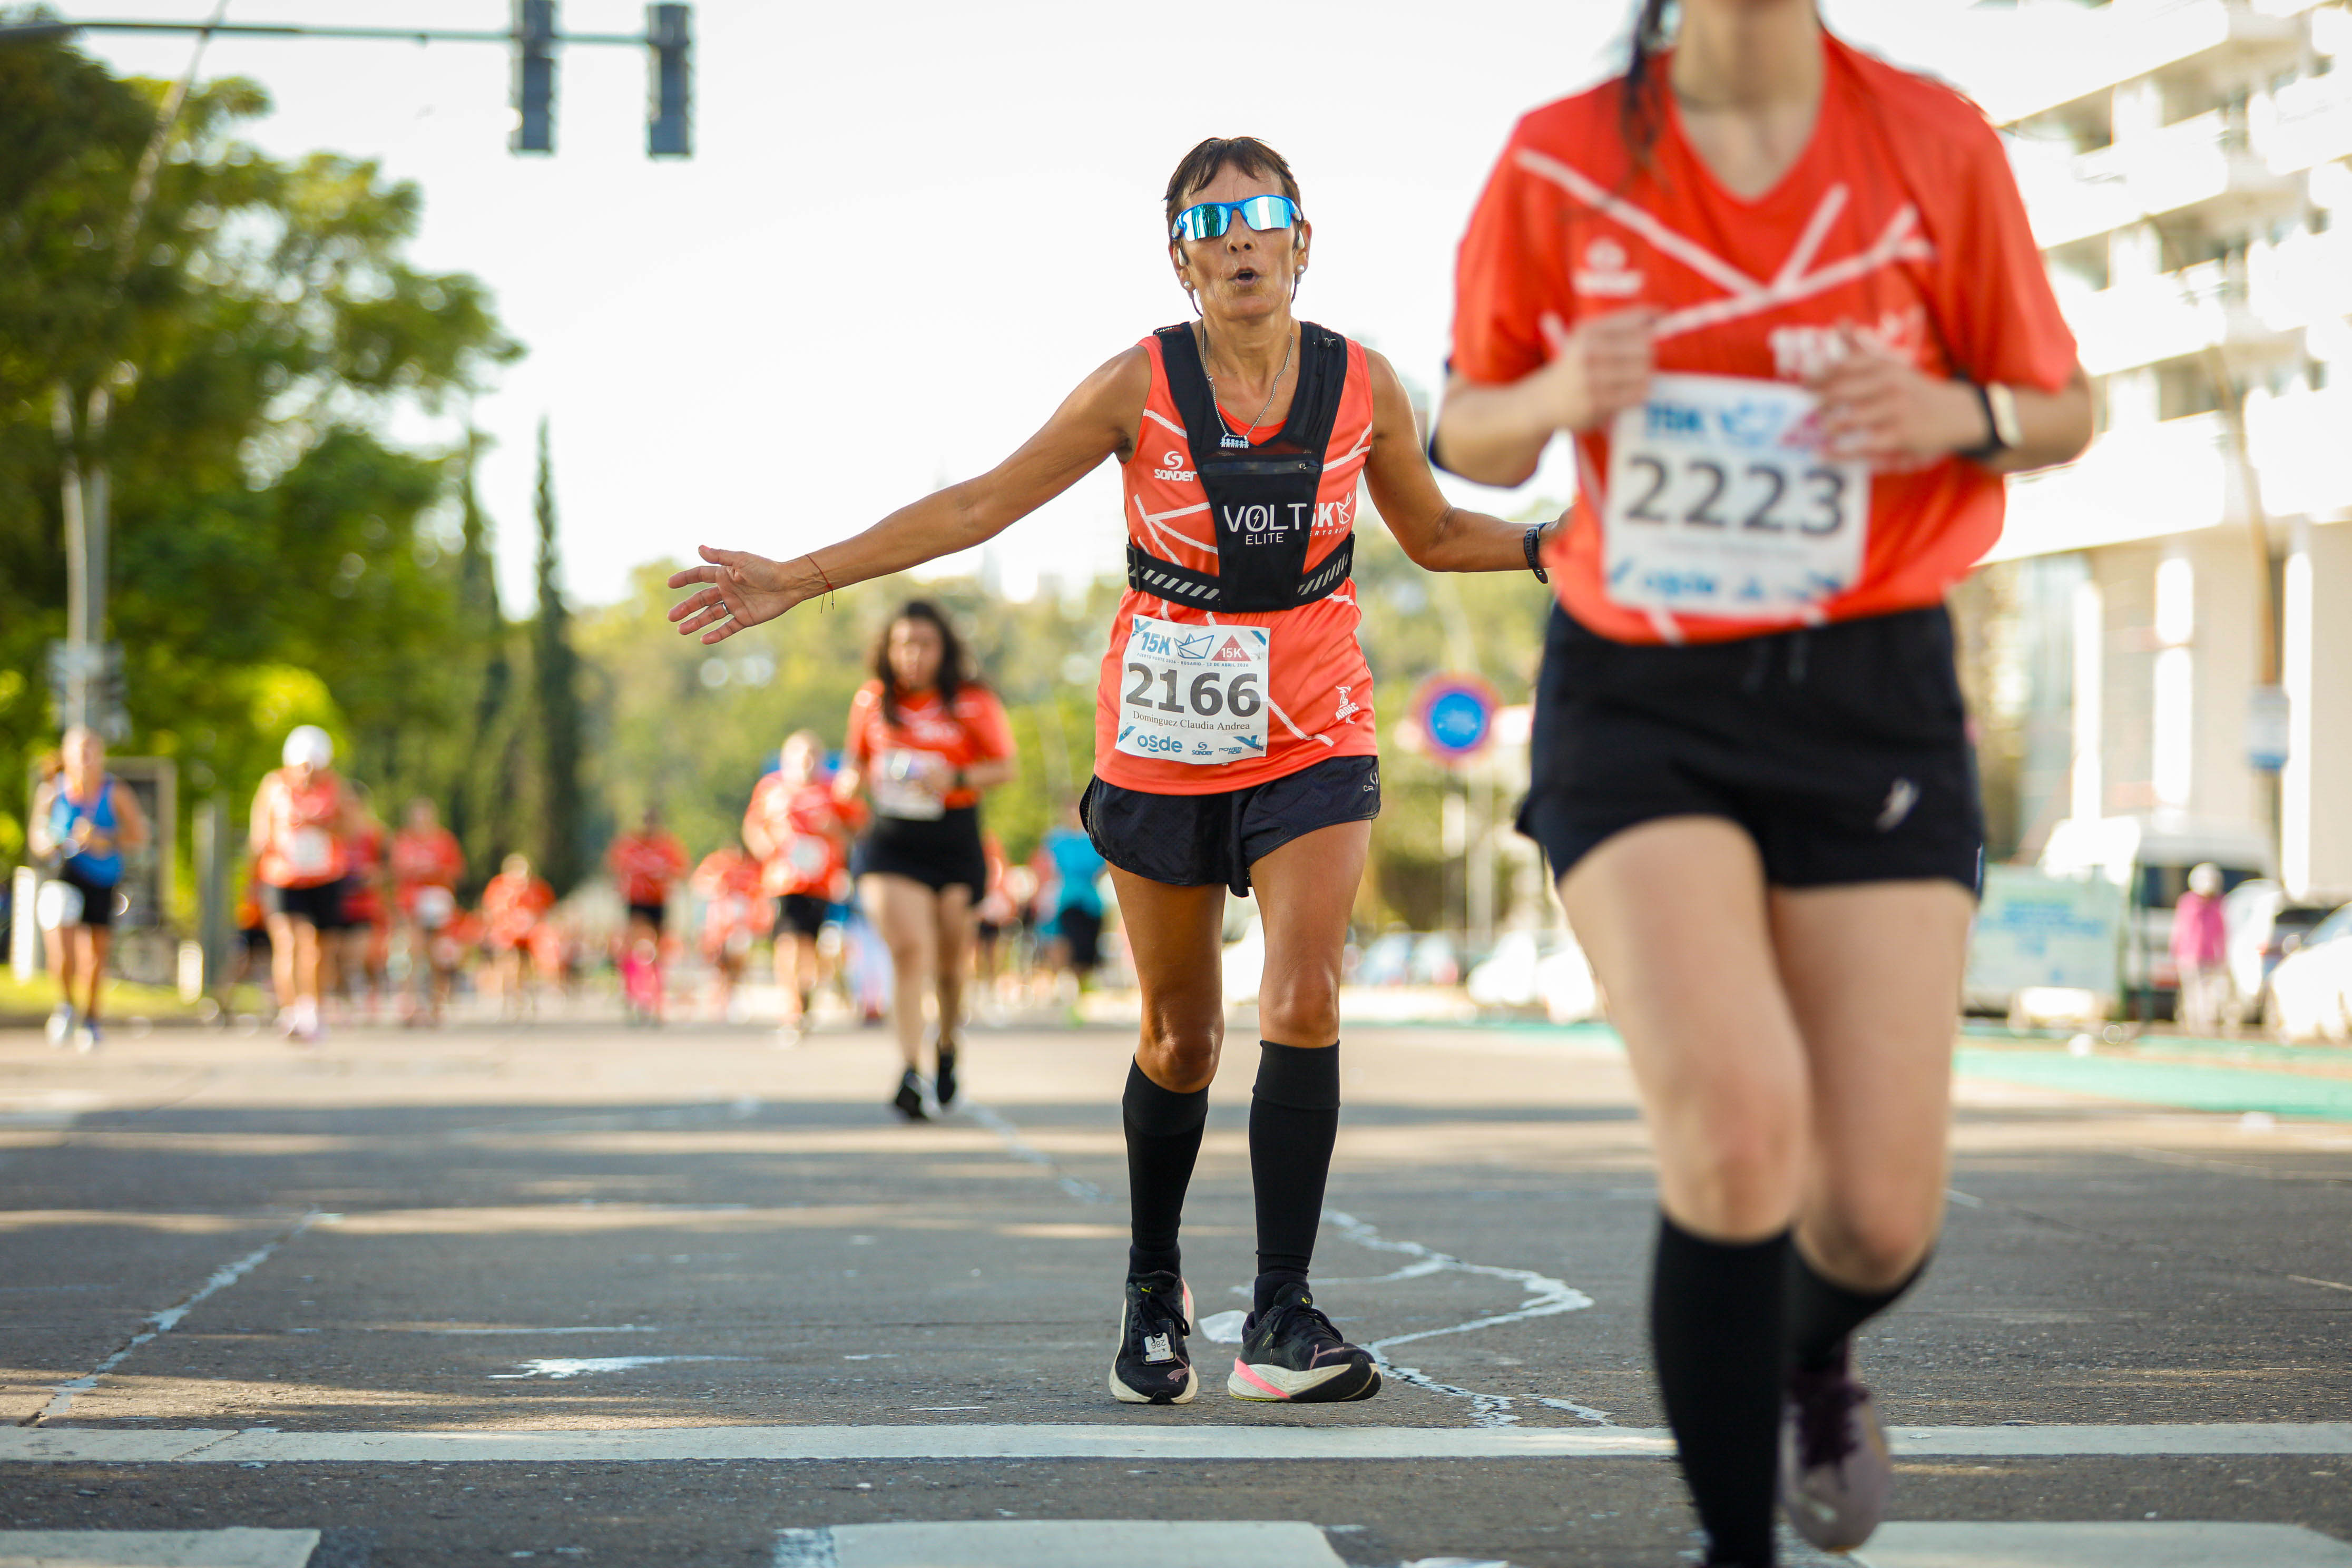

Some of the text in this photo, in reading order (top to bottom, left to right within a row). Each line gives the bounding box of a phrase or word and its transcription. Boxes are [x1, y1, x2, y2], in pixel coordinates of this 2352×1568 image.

[1623, 454, 1847, 536] 2223
[1223, 503, 1307, 532] VOLT
[1246, 532, 1284, 545] ELITE
[1142, 632, 1171, 655] 15K
[1221, 648, 1242, 658] 15K
[1126, 662, 1261, 717] 2166
[1133, 710, 1178, 727] Dominguez
[1180, 719, 1214, 730] Claudia
[1336, 702, 1359, 720] ARDEC
[1138, 734, 1183, 752] osde
